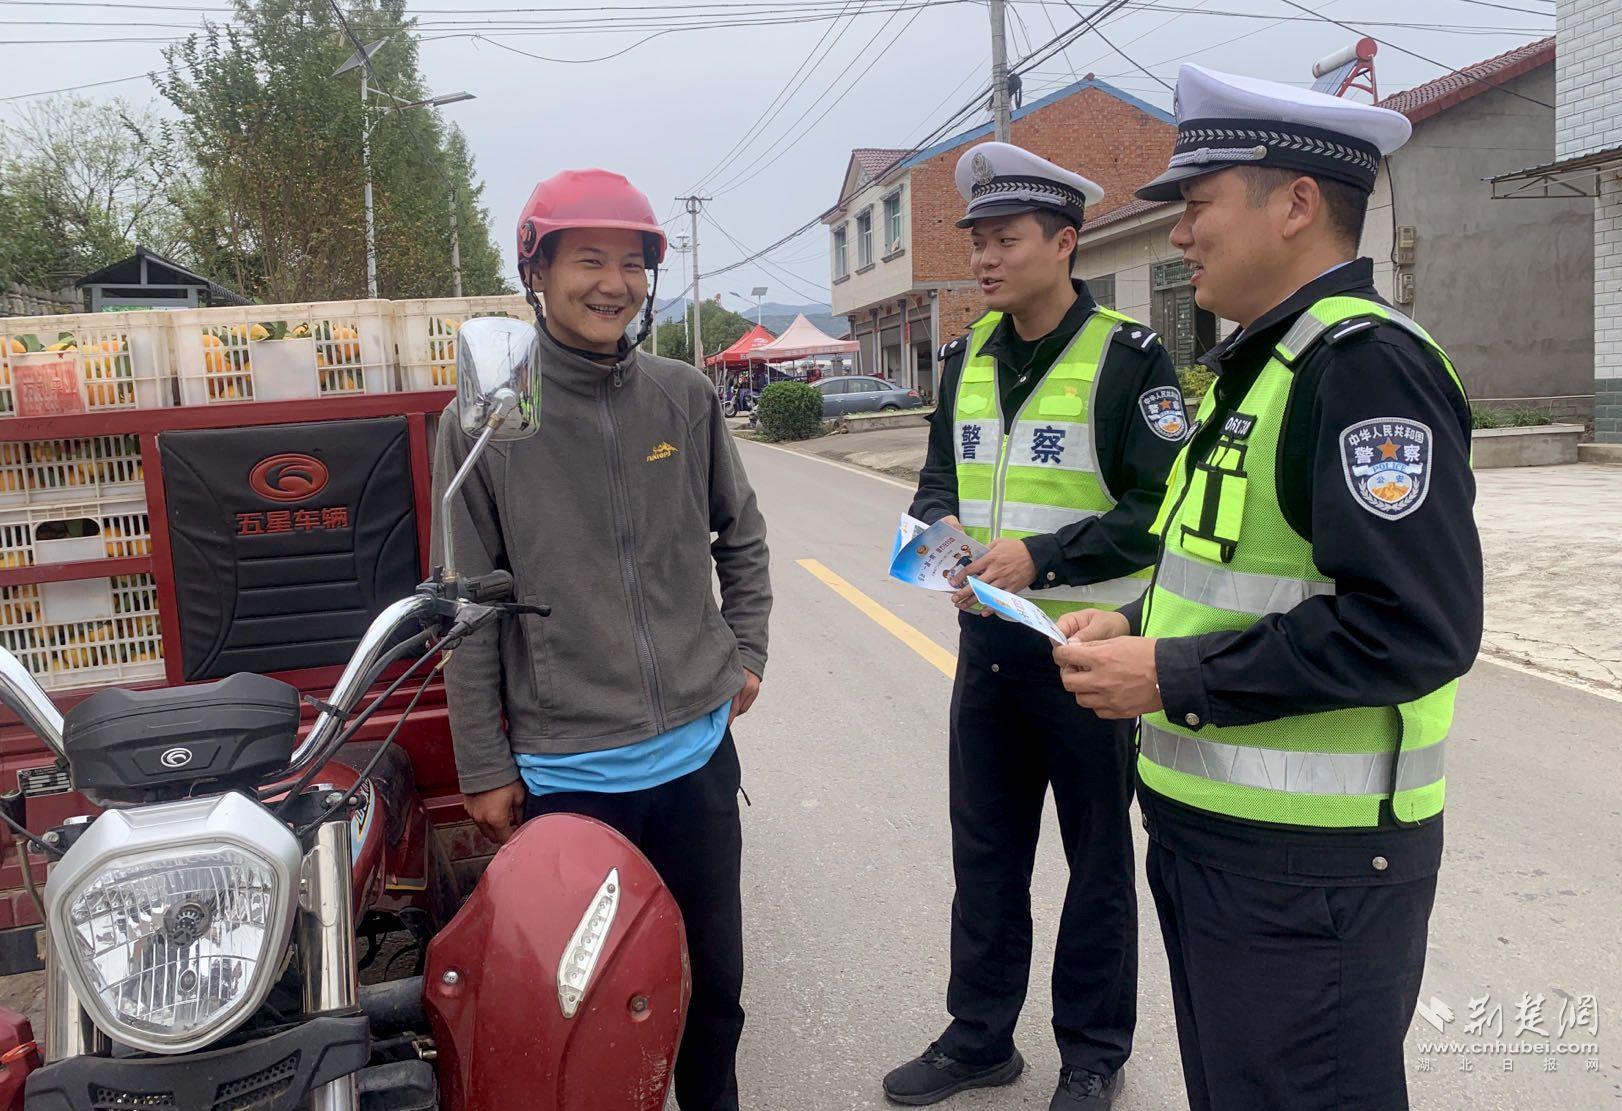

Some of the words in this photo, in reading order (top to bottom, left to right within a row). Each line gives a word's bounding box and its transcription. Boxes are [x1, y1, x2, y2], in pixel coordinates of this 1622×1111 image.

[1348, 424, 1424, 446] 中华人民共和国
[1372, 462, 1407, 473] POLICE
[236, 507, 348, 535] 五星车辆
